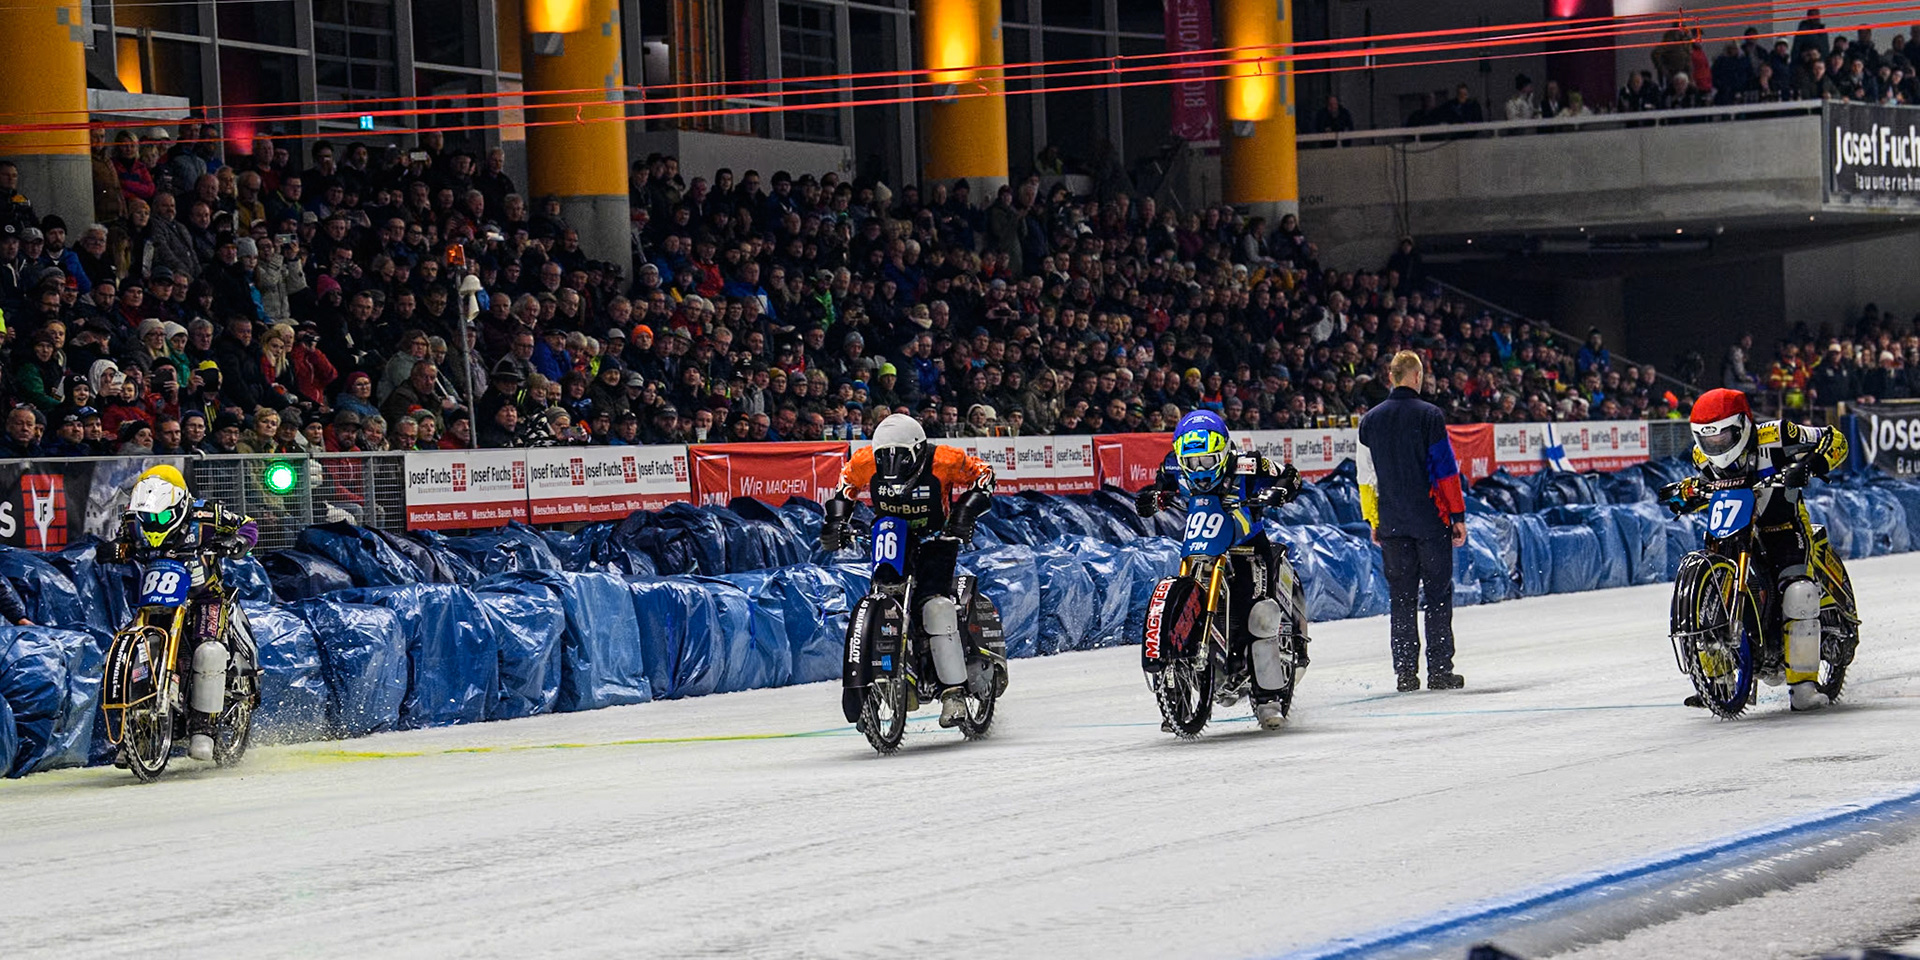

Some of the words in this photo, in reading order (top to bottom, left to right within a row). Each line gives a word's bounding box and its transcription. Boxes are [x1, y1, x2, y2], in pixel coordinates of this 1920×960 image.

[1835, 123, 1878, 174] Josef
[1880, 125, 1920, 168] Fuch
[1860, 414, 1920, 464] Jose
[470, 466, 490, 487] Josef
[491, 465, 511, 482] Fuchs
[530, 464, 549, 482] Josef
[550, 463, 570, 479] Fuchs
[585, 462, 602, 482] Josef
[603, 461, 622, 478] Fuchs
[638, 460, 655, 479] Josef
[655, 459, 674, 475] Fuchs
[1897, 457, 1920, 474] Bau
[409, 468, 429, 488] Josef
[430, 468, 451, 484] Fuchs
[766, 479, 808, 494] MACHEN
[410, 511, 436, 523] Menschen.
[437, 510, 452, 521] Bauen.
[452, 509, 468, 520] Werte.
[880, 501, 930, 514] BarBus.
[1710, 499, 1742, 531] 67
[0, 501, 16, 538] S
[1183, 511, 1224, 542] 199
[875, 531, 897, 562] 66
[1189, 541, 1208, 551] FIM
[142, 570, 180, 596] 88
